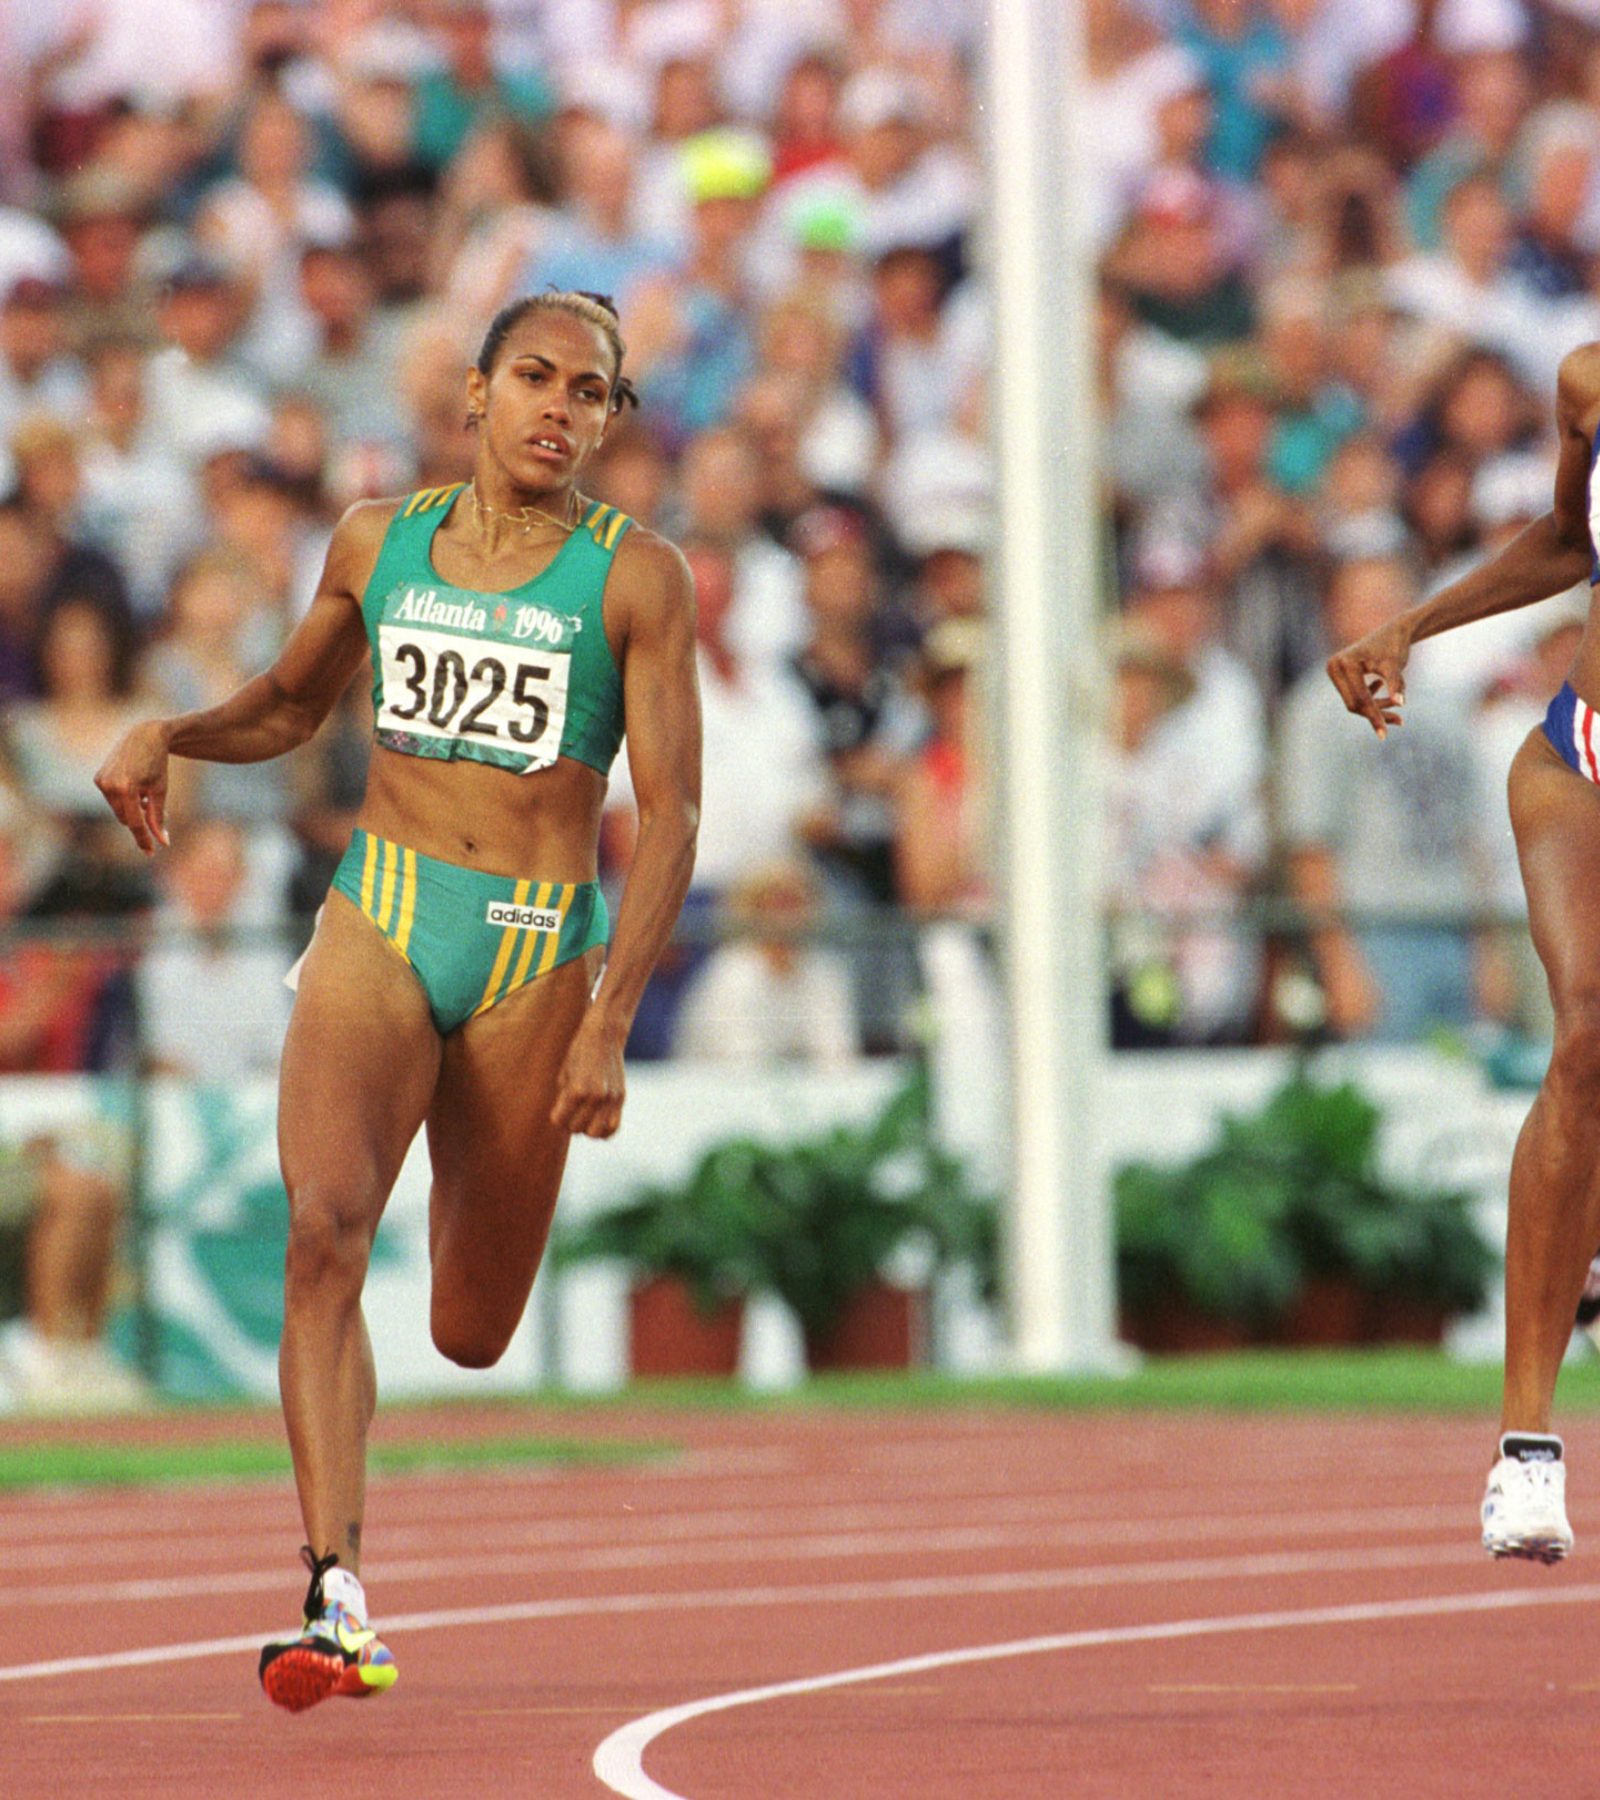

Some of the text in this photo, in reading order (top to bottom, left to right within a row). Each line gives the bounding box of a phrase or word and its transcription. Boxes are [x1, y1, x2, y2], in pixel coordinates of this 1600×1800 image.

[393, 587, 563, 644] Atlanta 1996
[390, 643, 551, 743] 3025
[490, 907, 556, 929] adidas
